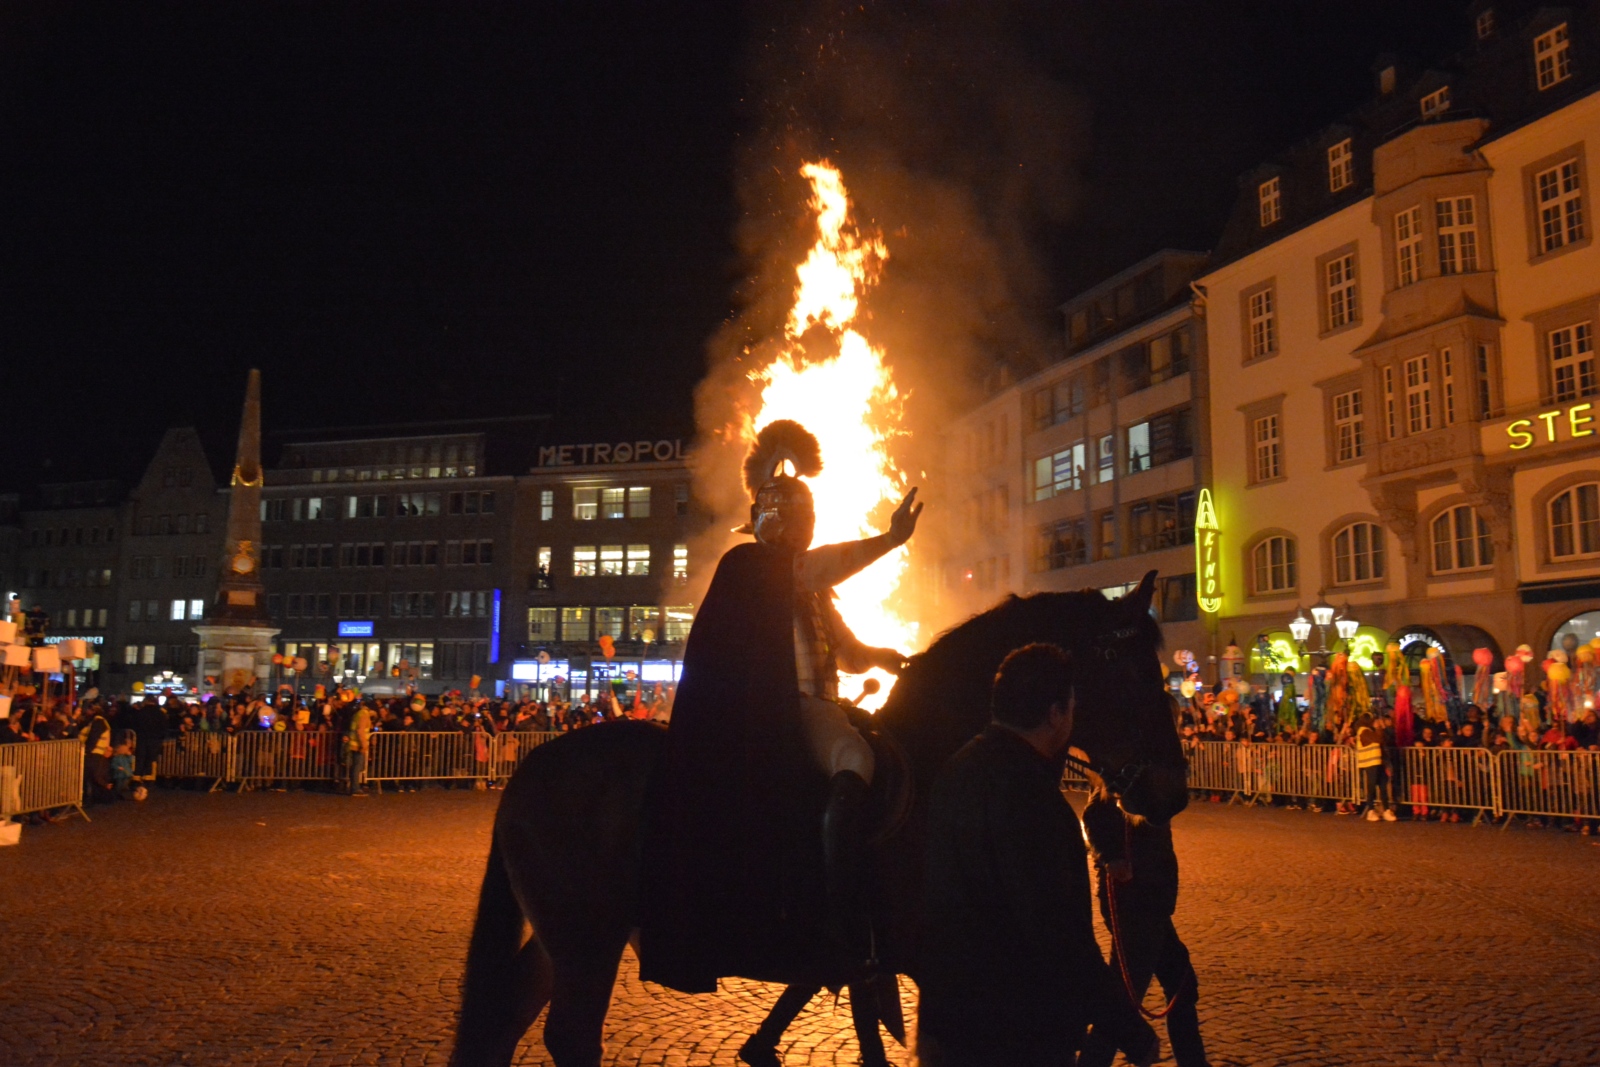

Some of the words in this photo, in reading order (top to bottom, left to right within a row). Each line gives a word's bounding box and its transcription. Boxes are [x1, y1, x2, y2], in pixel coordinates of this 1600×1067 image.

[1507, 403, 1593, 450] STE
[538, 439, 692, 466] METROPOL
[1203, 531, 1217, 595] KINO
